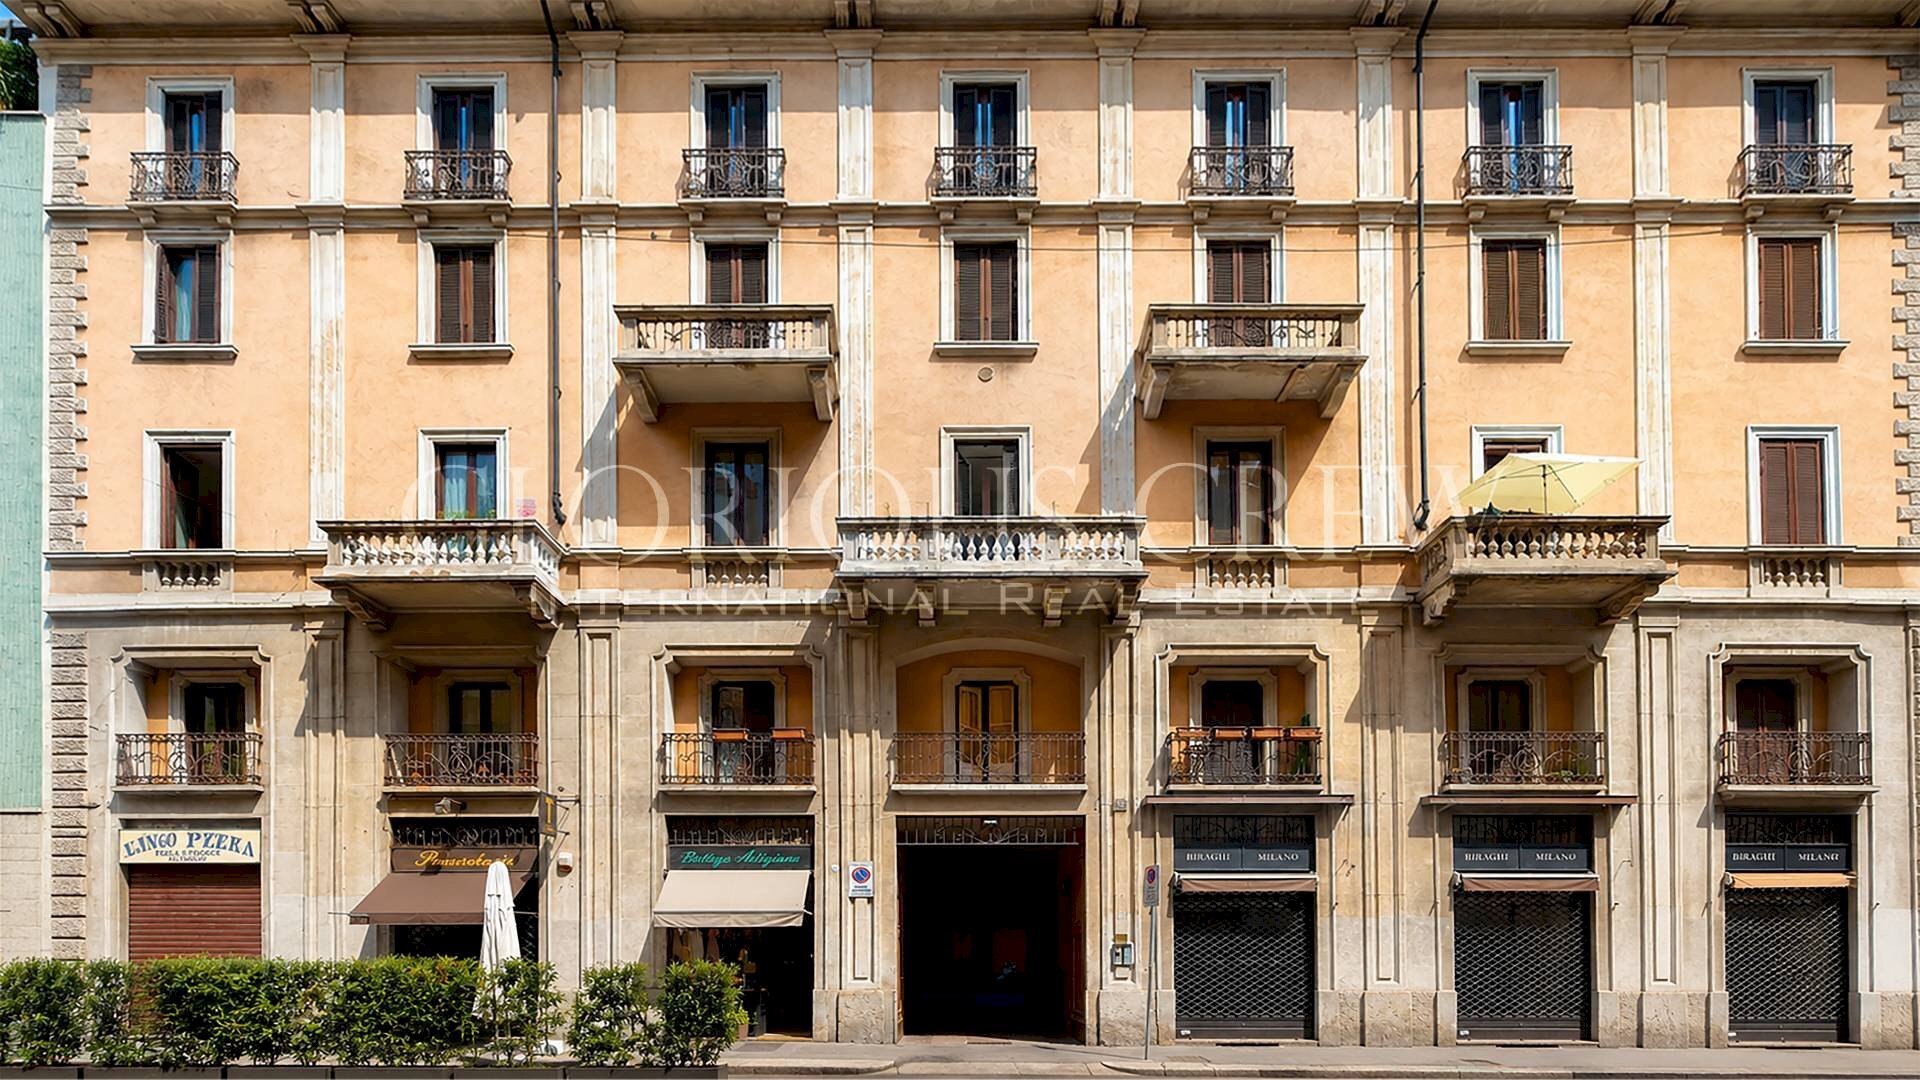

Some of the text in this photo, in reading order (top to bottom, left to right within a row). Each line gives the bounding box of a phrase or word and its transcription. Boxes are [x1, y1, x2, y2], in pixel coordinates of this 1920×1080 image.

[1258, 852, 1299, 861] MILANO
[1535, 852, 1577, 861] MILANO
[1798, 852, 1840, 861] MILANO
